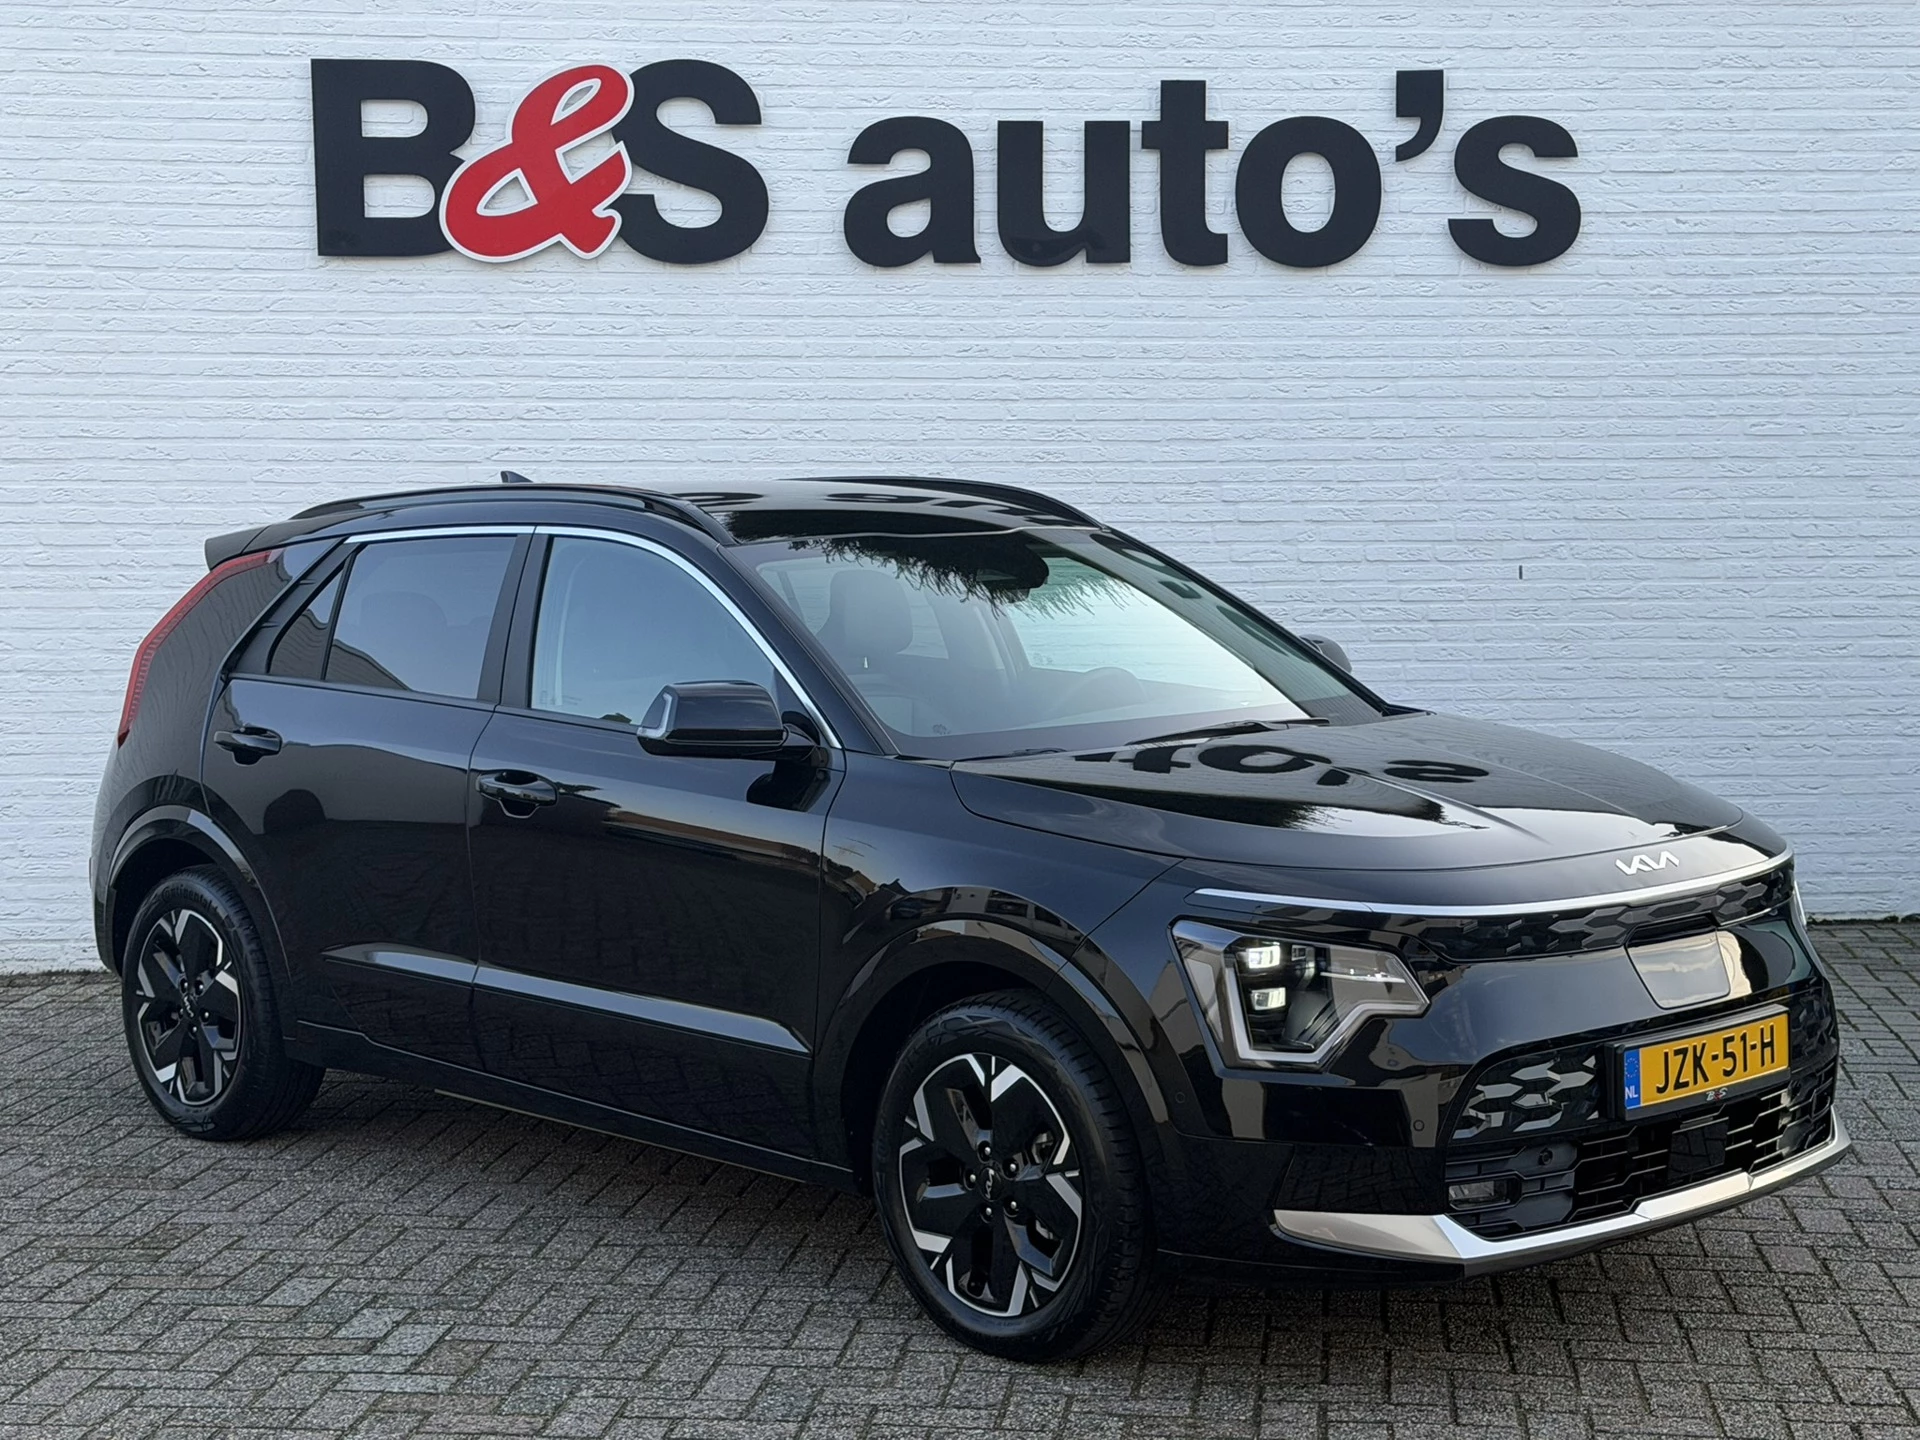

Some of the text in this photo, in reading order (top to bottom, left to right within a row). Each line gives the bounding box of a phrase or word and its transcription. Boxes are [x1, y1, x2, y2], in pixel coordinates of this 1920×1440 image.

[311, 58, 1581, 268] B&S auto's
[1625, 1085, 1639, 1099] NL
[1656, 1023, 1775, 1094] JZK-51-H
